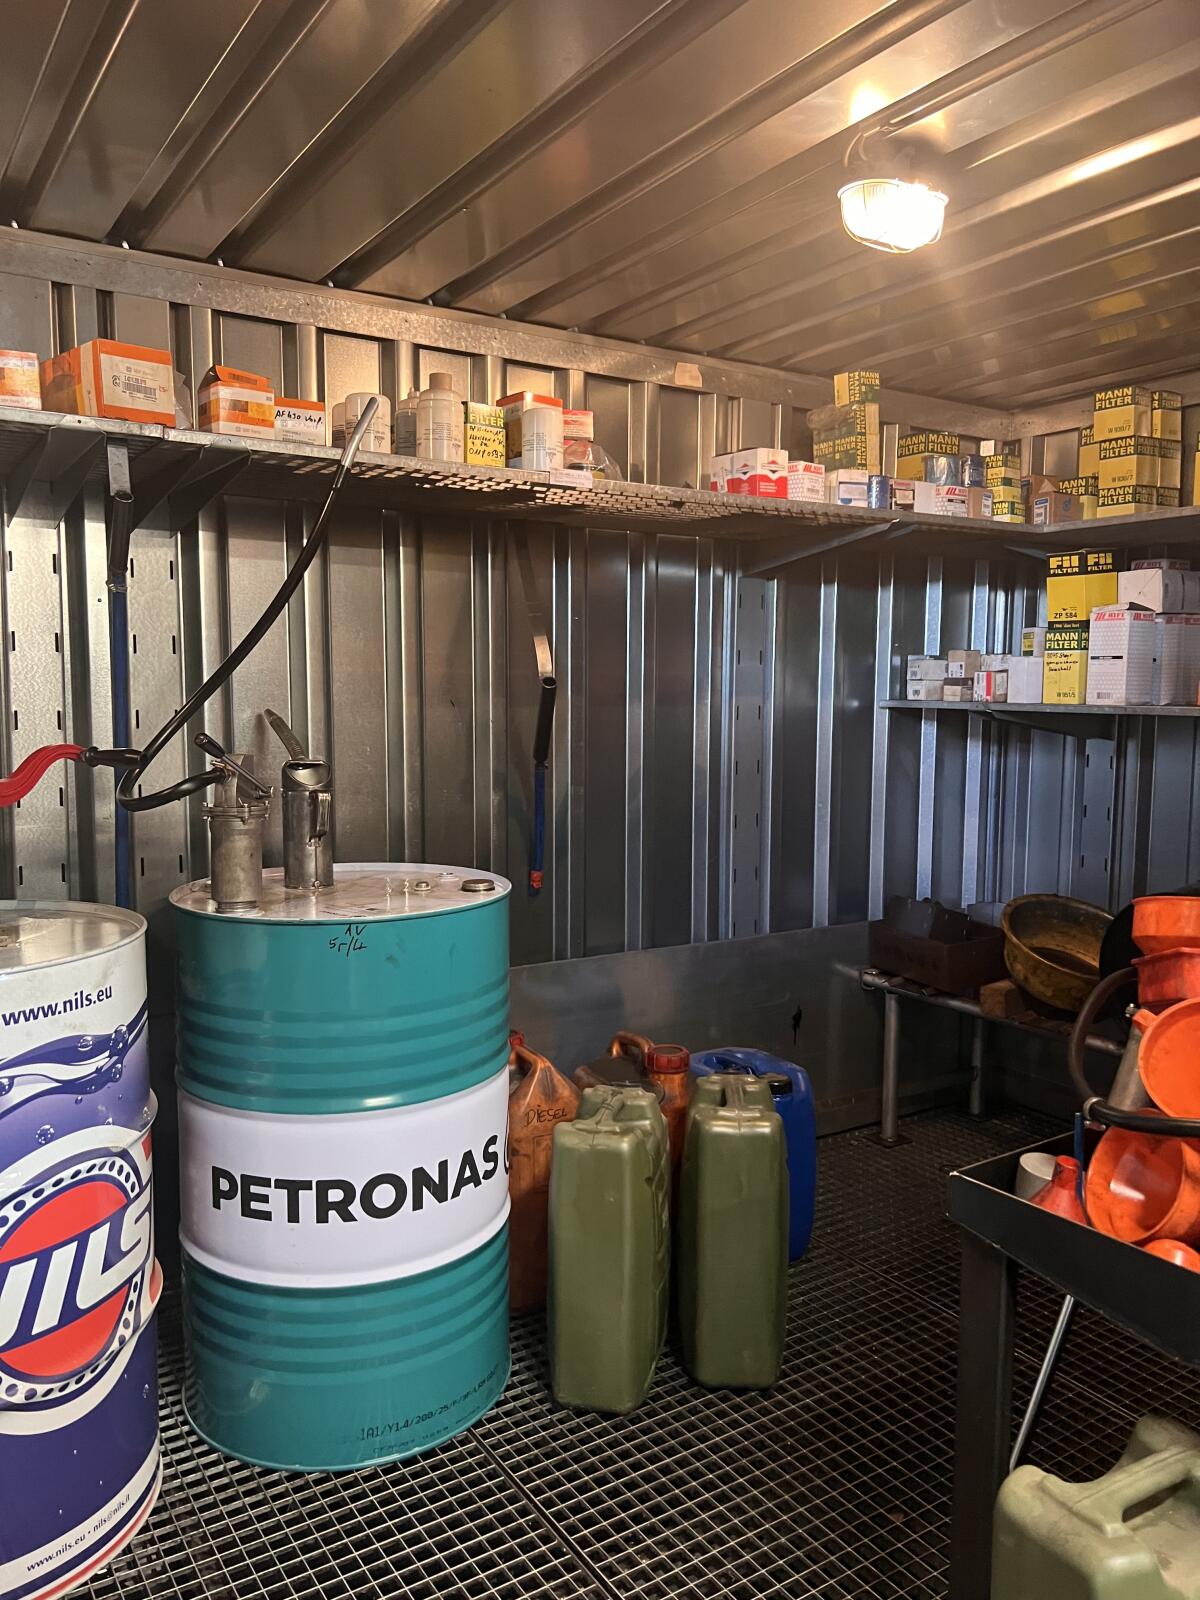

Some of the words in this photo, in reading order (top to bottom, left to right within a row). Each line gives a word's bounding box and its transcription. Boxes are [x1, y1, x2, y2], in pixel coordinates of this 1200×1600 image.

[1096, 387, 1132, 402] MANN
[1096, 396, 1132, 410] FILTER
[470, 412, 504, 428] FILTER
[899, 433, 926, 447] MANN
[929, 433, 959, 446] MANN
[1101, 437, 1135, 451] MANN
[898, 444, 925, 457] FILTER
[929, 443, 959, 455] FILTER
[1101, 446, 1134, 459] FILTER
[1099, 486, 1133, 498] MANN
[1099, 495, 1132, 506] FILTER
[1050, 567, 1079, 575] FILTER
[1087, 564, 1113, 572] FILTER
[1046, 632, 1078, 641] MANN
[1046, 640, 1078, 649] FILTER
[1, 985, 113, 1027] www.nils.eu
[211, 1134, 499, 1224] PETRONAS
[26, 1533, 86, 1572] www.nils.eu
